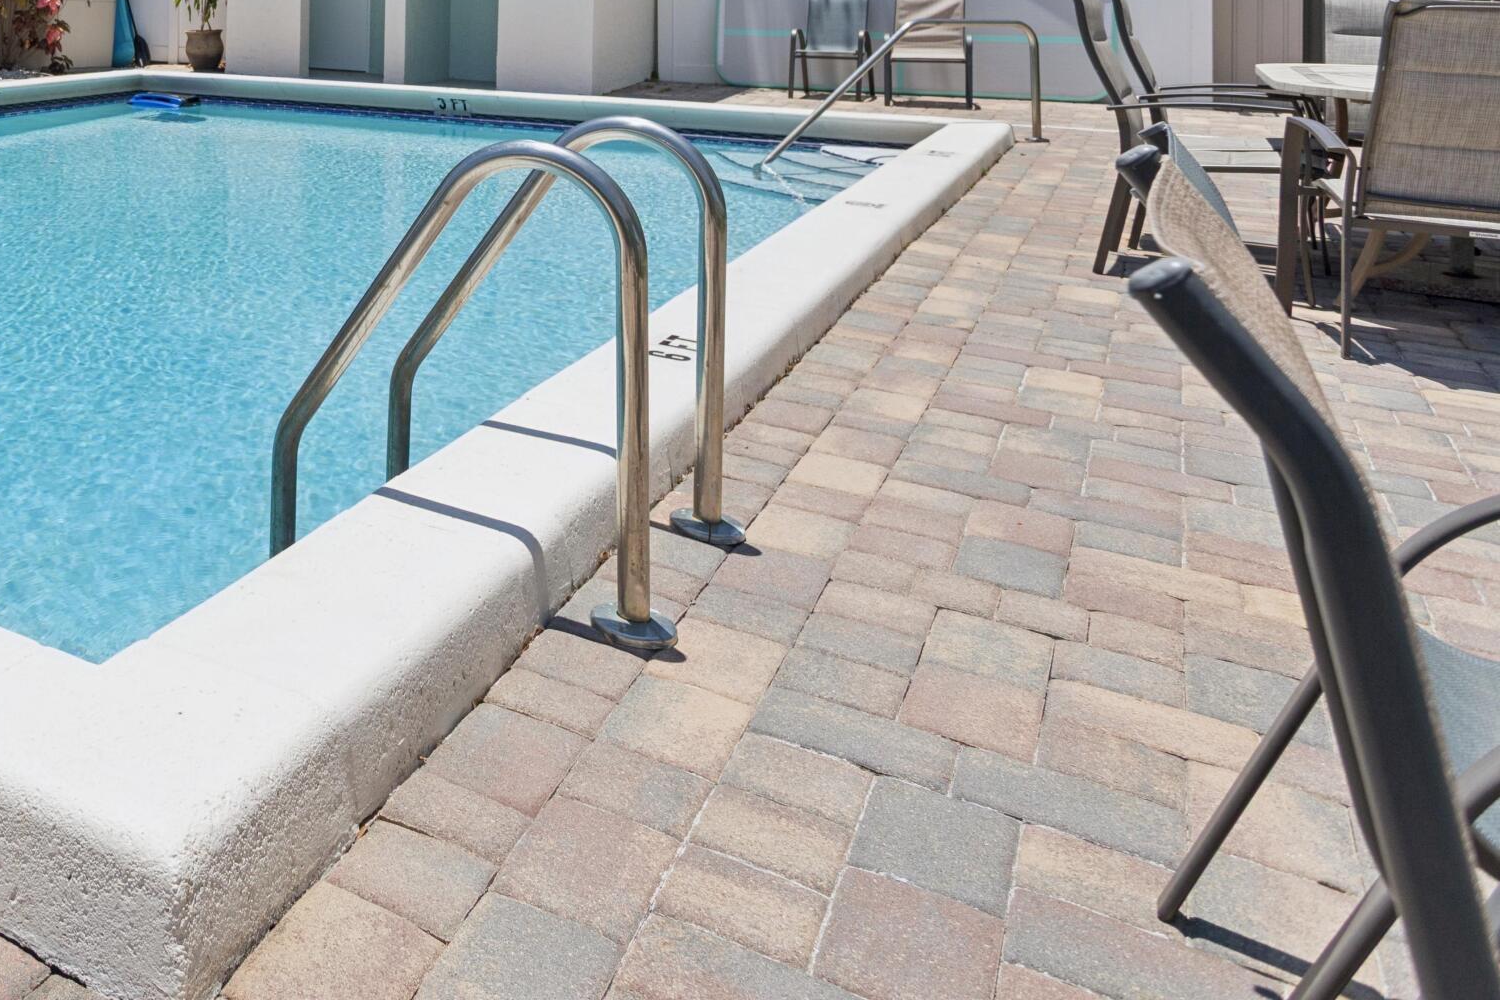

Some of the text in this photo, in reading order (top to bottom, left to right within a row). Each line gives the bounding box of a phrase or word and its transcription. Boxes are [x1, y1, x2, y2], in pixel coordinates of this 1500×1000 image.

[437, 98, 468, 111] 3 FT
[648, 334, 698, 362] 6 FT
